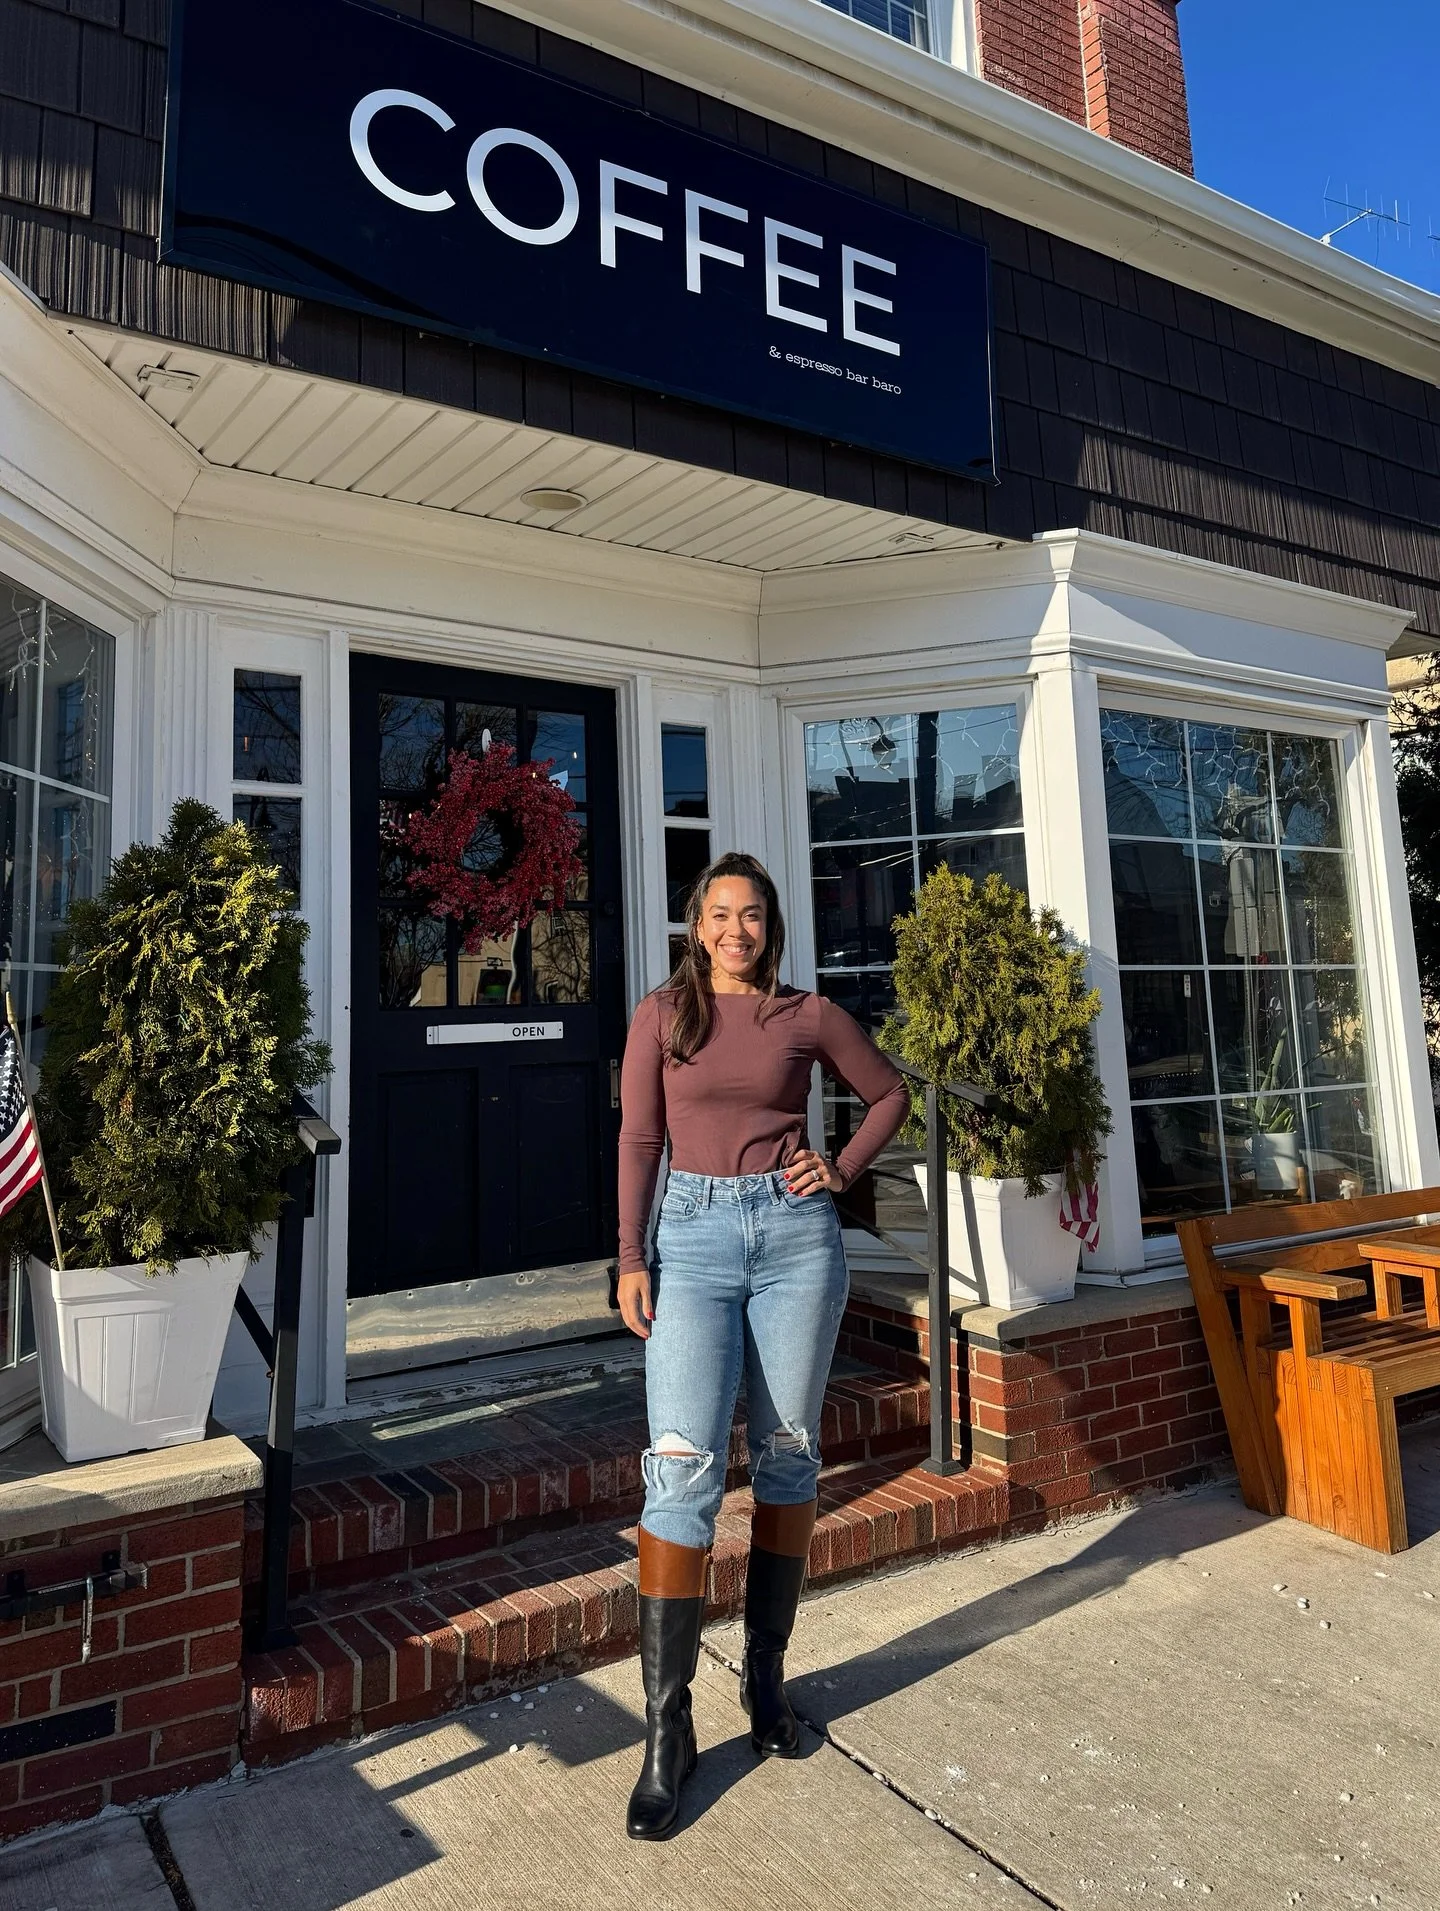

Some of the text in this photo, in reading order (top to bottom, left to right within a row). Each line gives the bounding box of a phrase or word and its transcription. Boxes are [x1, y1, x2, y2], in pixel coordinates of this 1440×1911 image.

[350, 88, 901, 357] COFFEE
[769, 345, 902, 395] & espresso bar baro
[512, 1026, 545, 1037] OPEN
